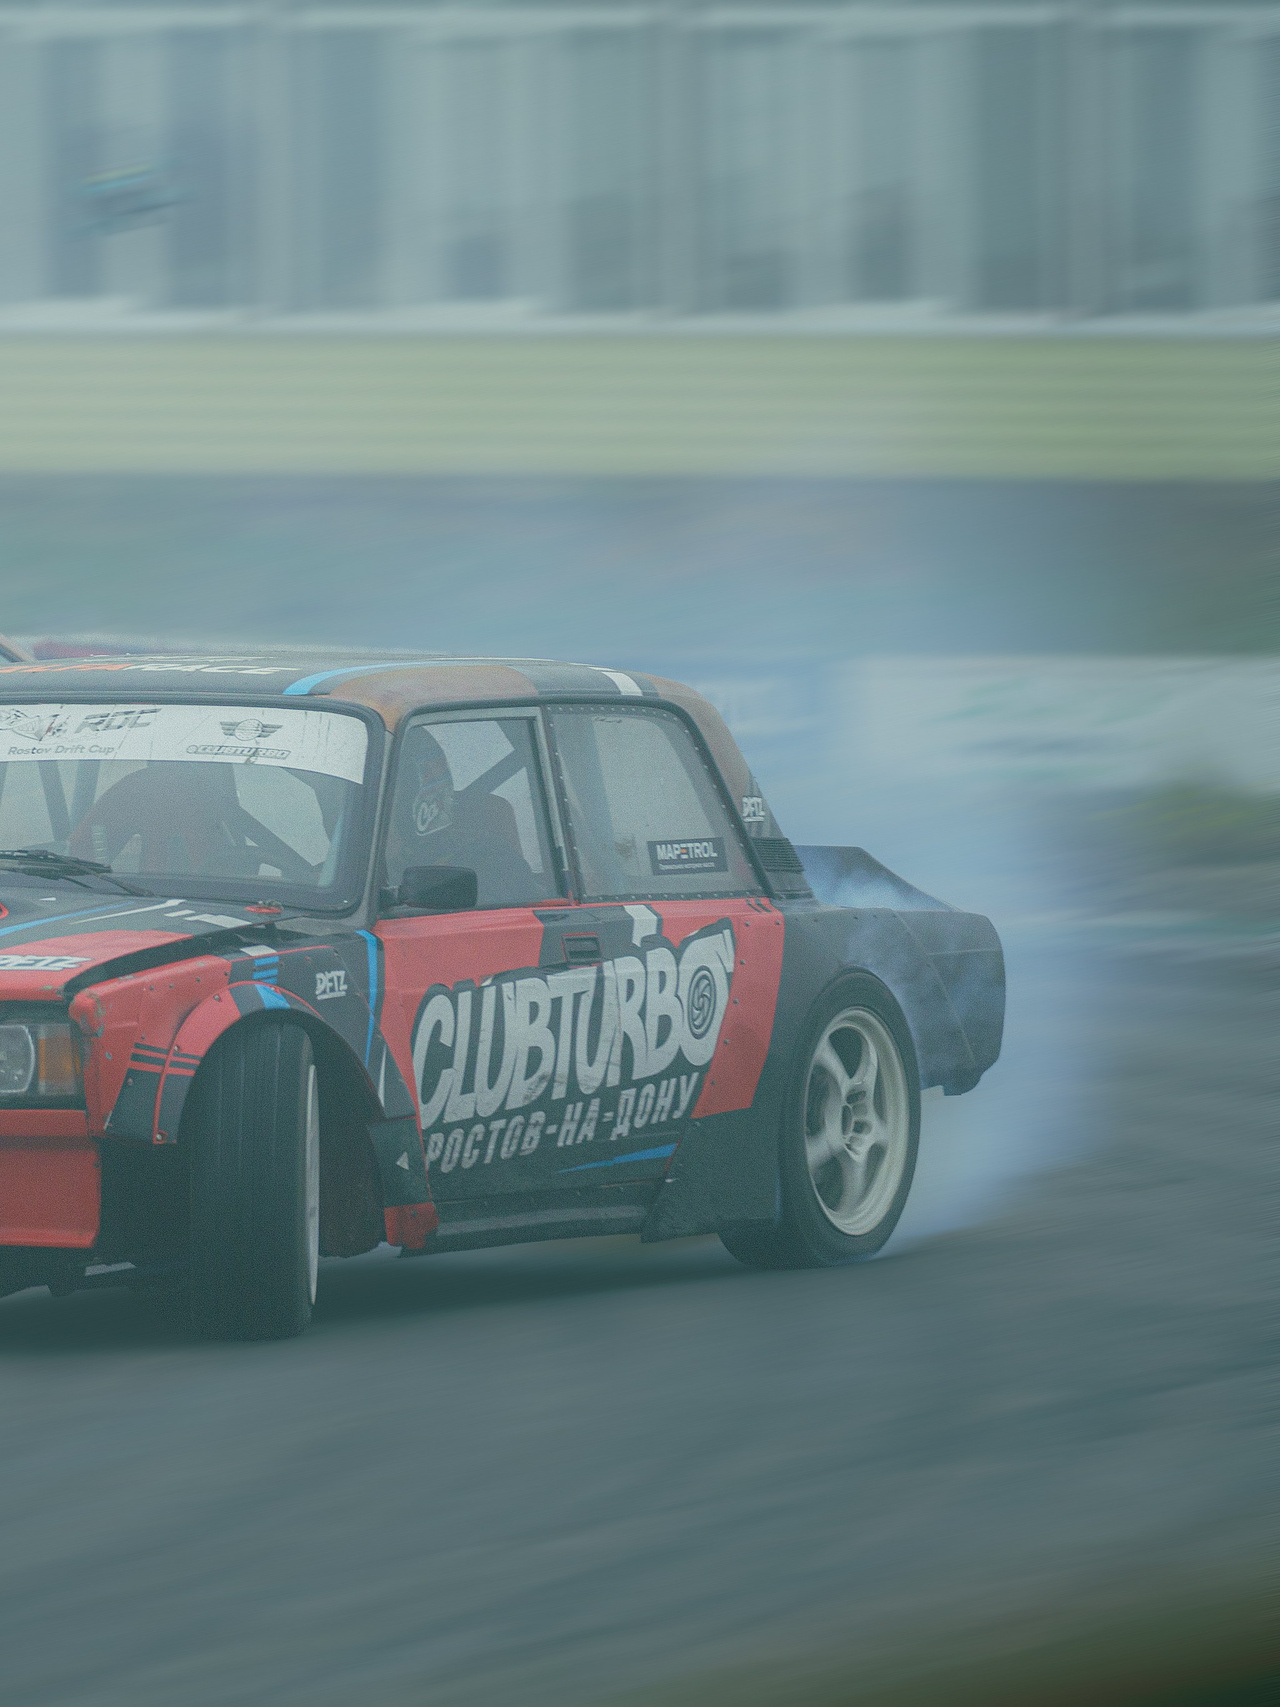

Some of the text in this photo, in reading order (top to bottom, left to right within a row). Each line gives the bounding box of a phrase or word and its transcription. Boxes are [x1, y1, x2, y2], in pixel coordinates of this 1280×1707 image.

[74, 708, 162, 734] RDC
[7, 744, 115, 756] Rostov Drift Cup
[655, 841, 719, 860] MAPETROL
[413, 929, 735, 1131] CLUBTURBO
[425, 1073, 700, 1175] РОСТОВ-НА-ДОНУ
